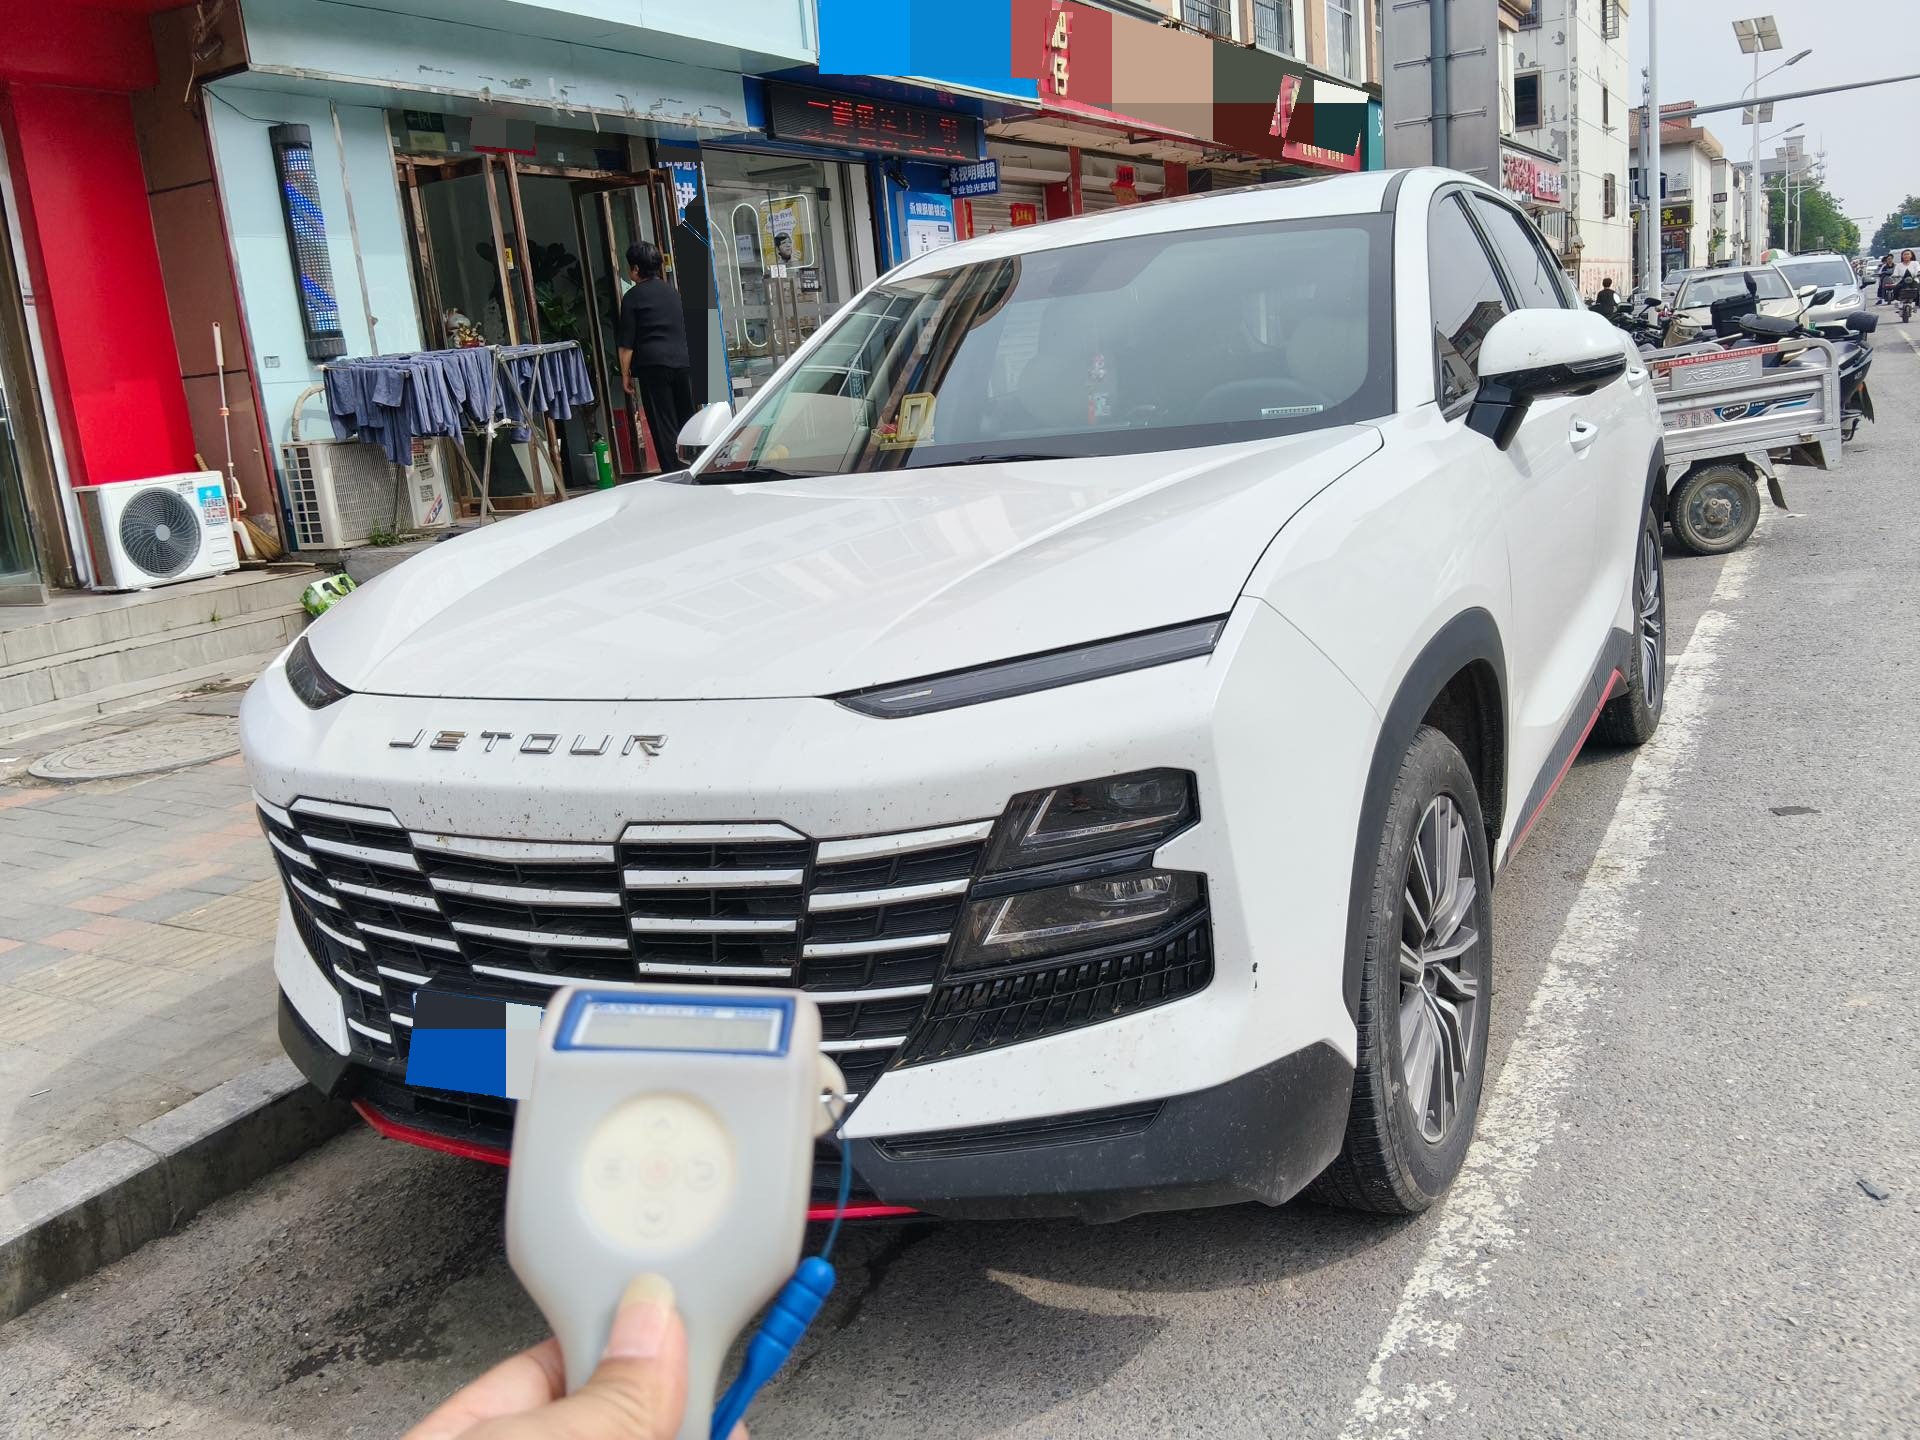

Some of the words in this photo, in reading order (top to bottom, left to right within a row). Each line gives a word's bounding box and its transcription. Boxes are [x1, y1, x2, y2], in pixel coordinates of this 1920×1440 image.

[950, 161, 996, 183] 永视明眼镜
[952, 181, 996, 195] 专业验光配镜
[389, 728, 669, 756] JETOUR
